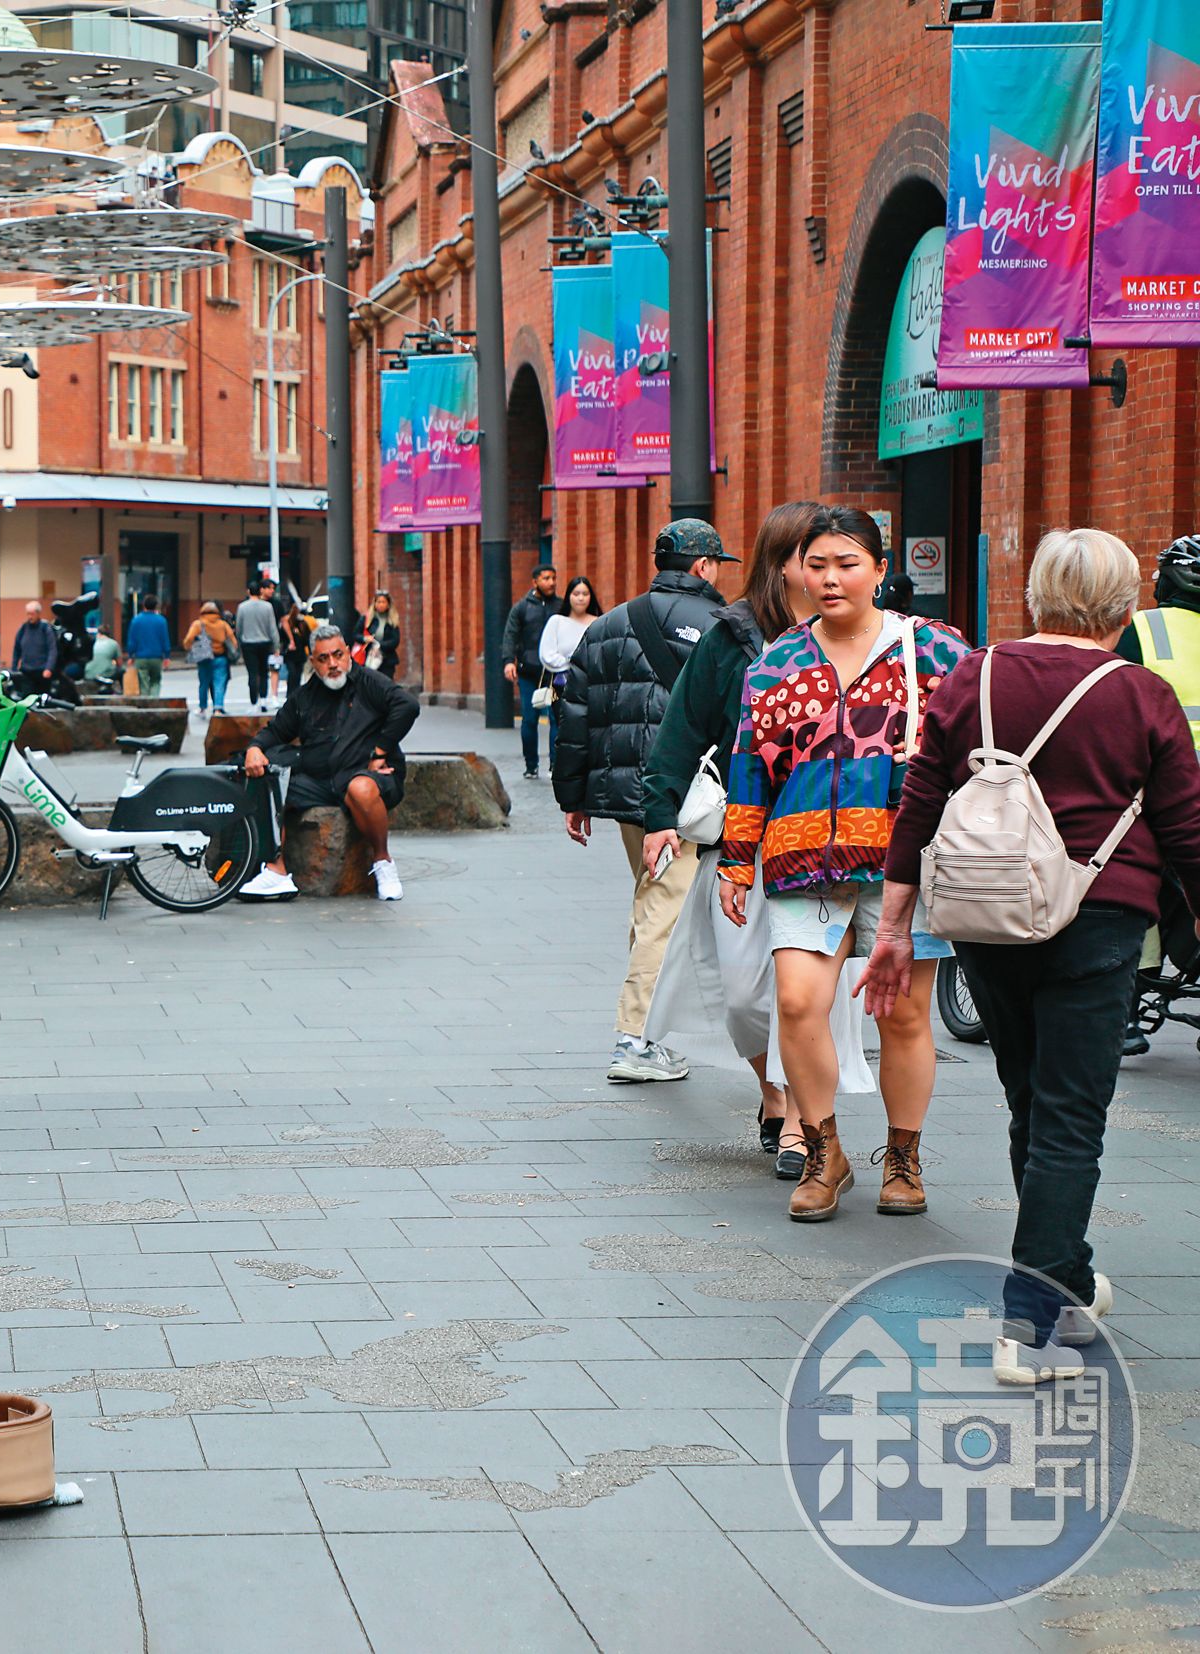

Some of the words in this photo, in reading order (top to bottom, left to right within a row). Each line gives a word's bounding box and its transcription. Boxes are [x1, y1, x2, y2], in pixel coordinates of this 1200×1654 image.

[974, 144, 1069, 189] Vivid
[1135, 185, 1169, 197] OPEN
[1173, 184, 1193, 195] TILL
[957, 194, 1076, 255] Lights
[978, 259, 1048, 269] MESMERISING
[1127, 280, 1186, 296] MARKET
[1128, 302, 1181, 311] SHOPPING
[969, 332, 1020, 346] MARKET
[1026, 331, 1054, 345] CITY
[970, 350, 1017, 358] SHOPPING
[636, 379, 656, 387] OPEN
[422, 411, 467, 433] Vivid
[636, 435, 670, 445] MARKET
[573, 452, 605, 461] MARKET
[23, 779, 66, 828] Lime
[208, 803, 235, 814] Lime
